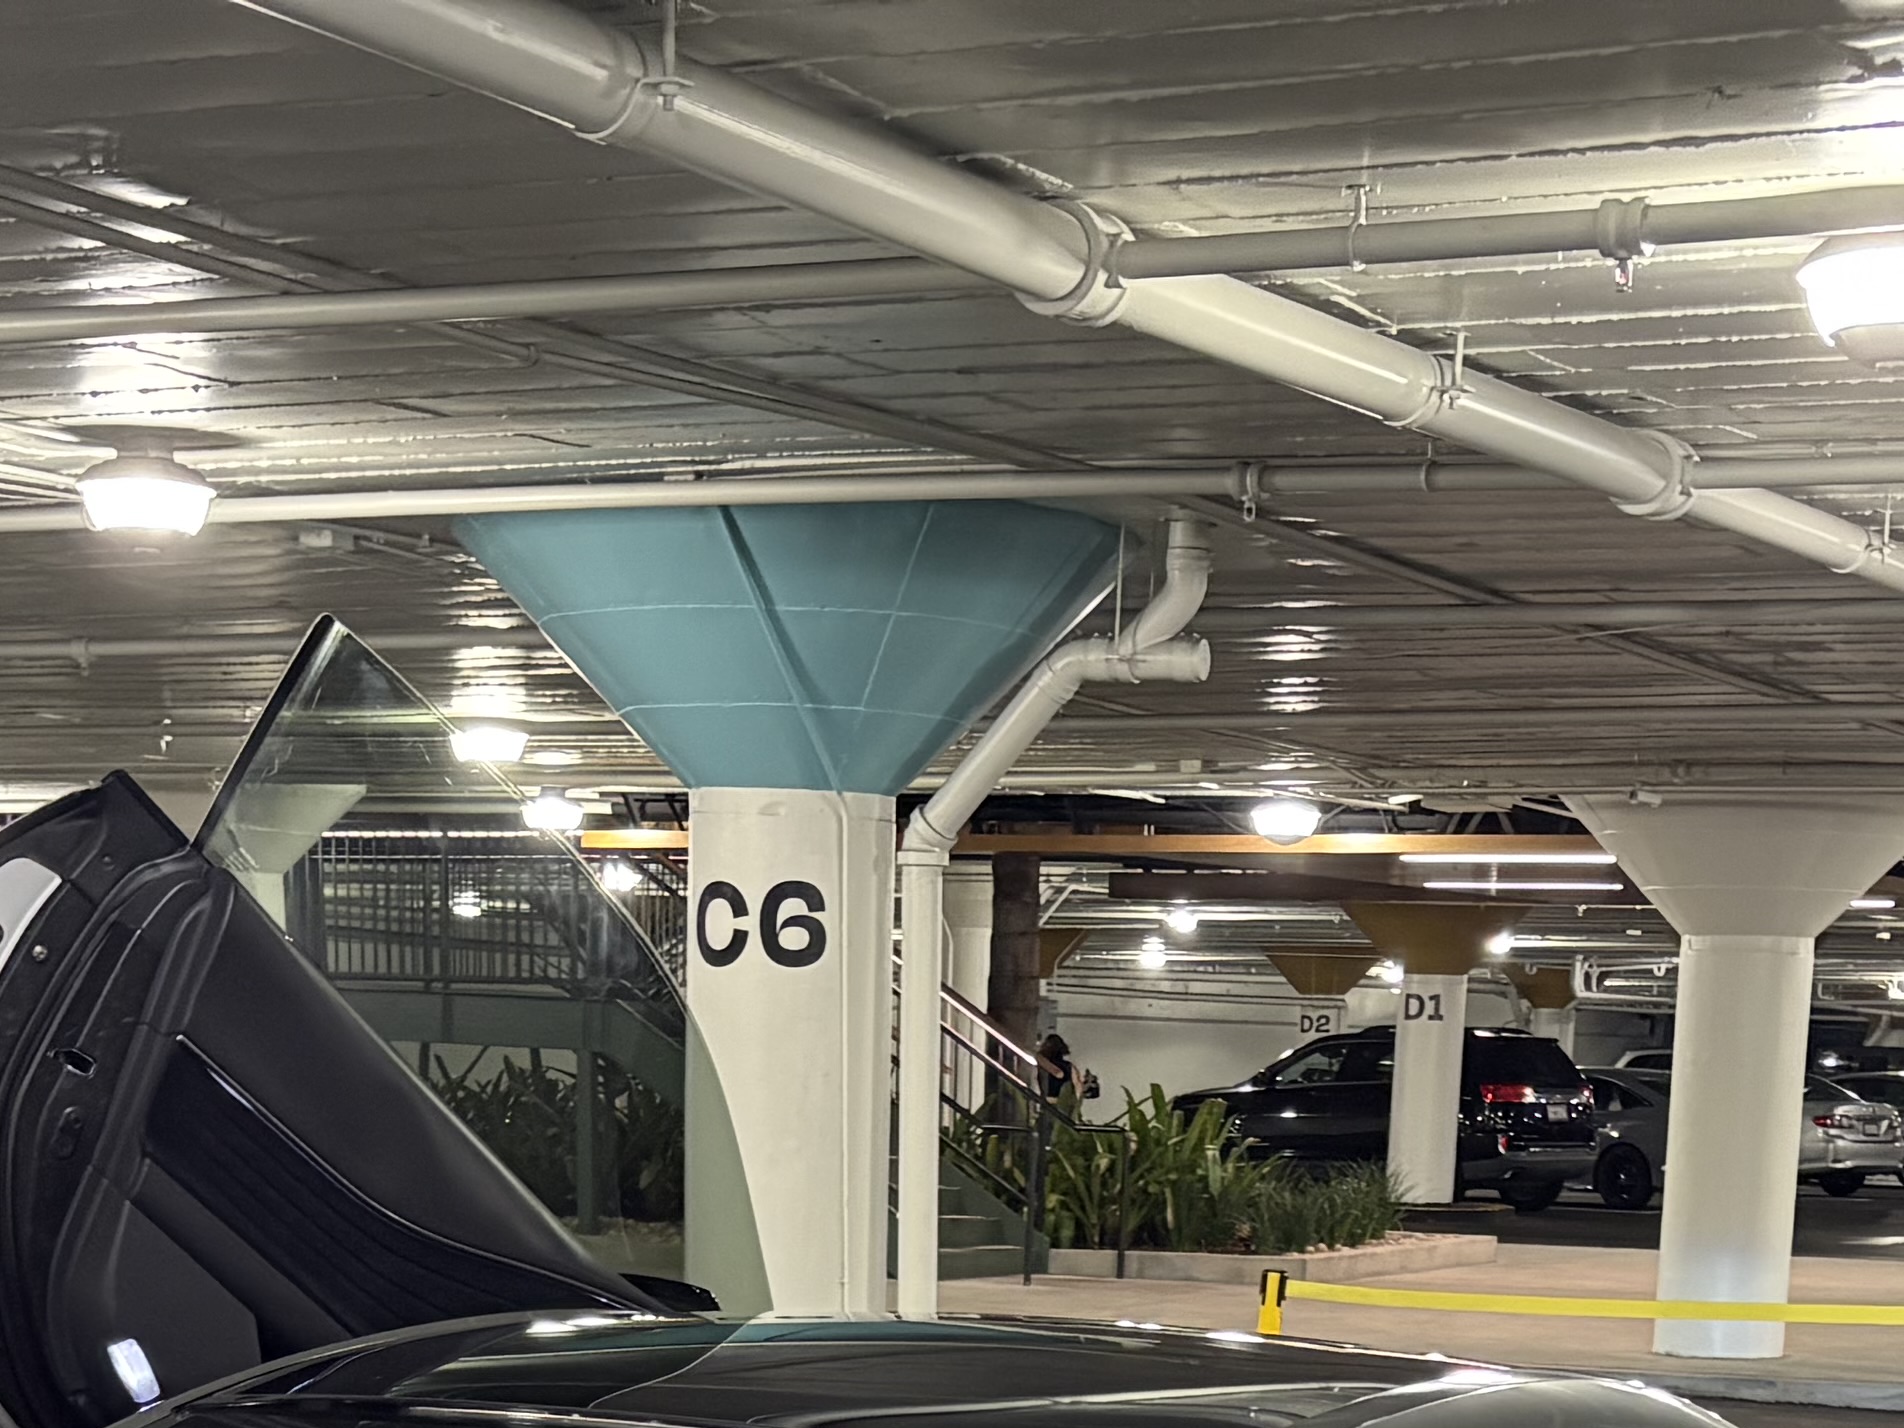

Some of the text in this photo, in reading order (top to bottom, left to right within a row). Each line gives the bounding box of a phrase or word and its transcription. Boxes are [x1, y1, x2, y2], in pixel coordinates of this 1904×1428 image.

[697, 880, 827, 968] C6
[1404, 994, 1444, 1021] D1
[1300, 1015, 1330, 1033] D2
